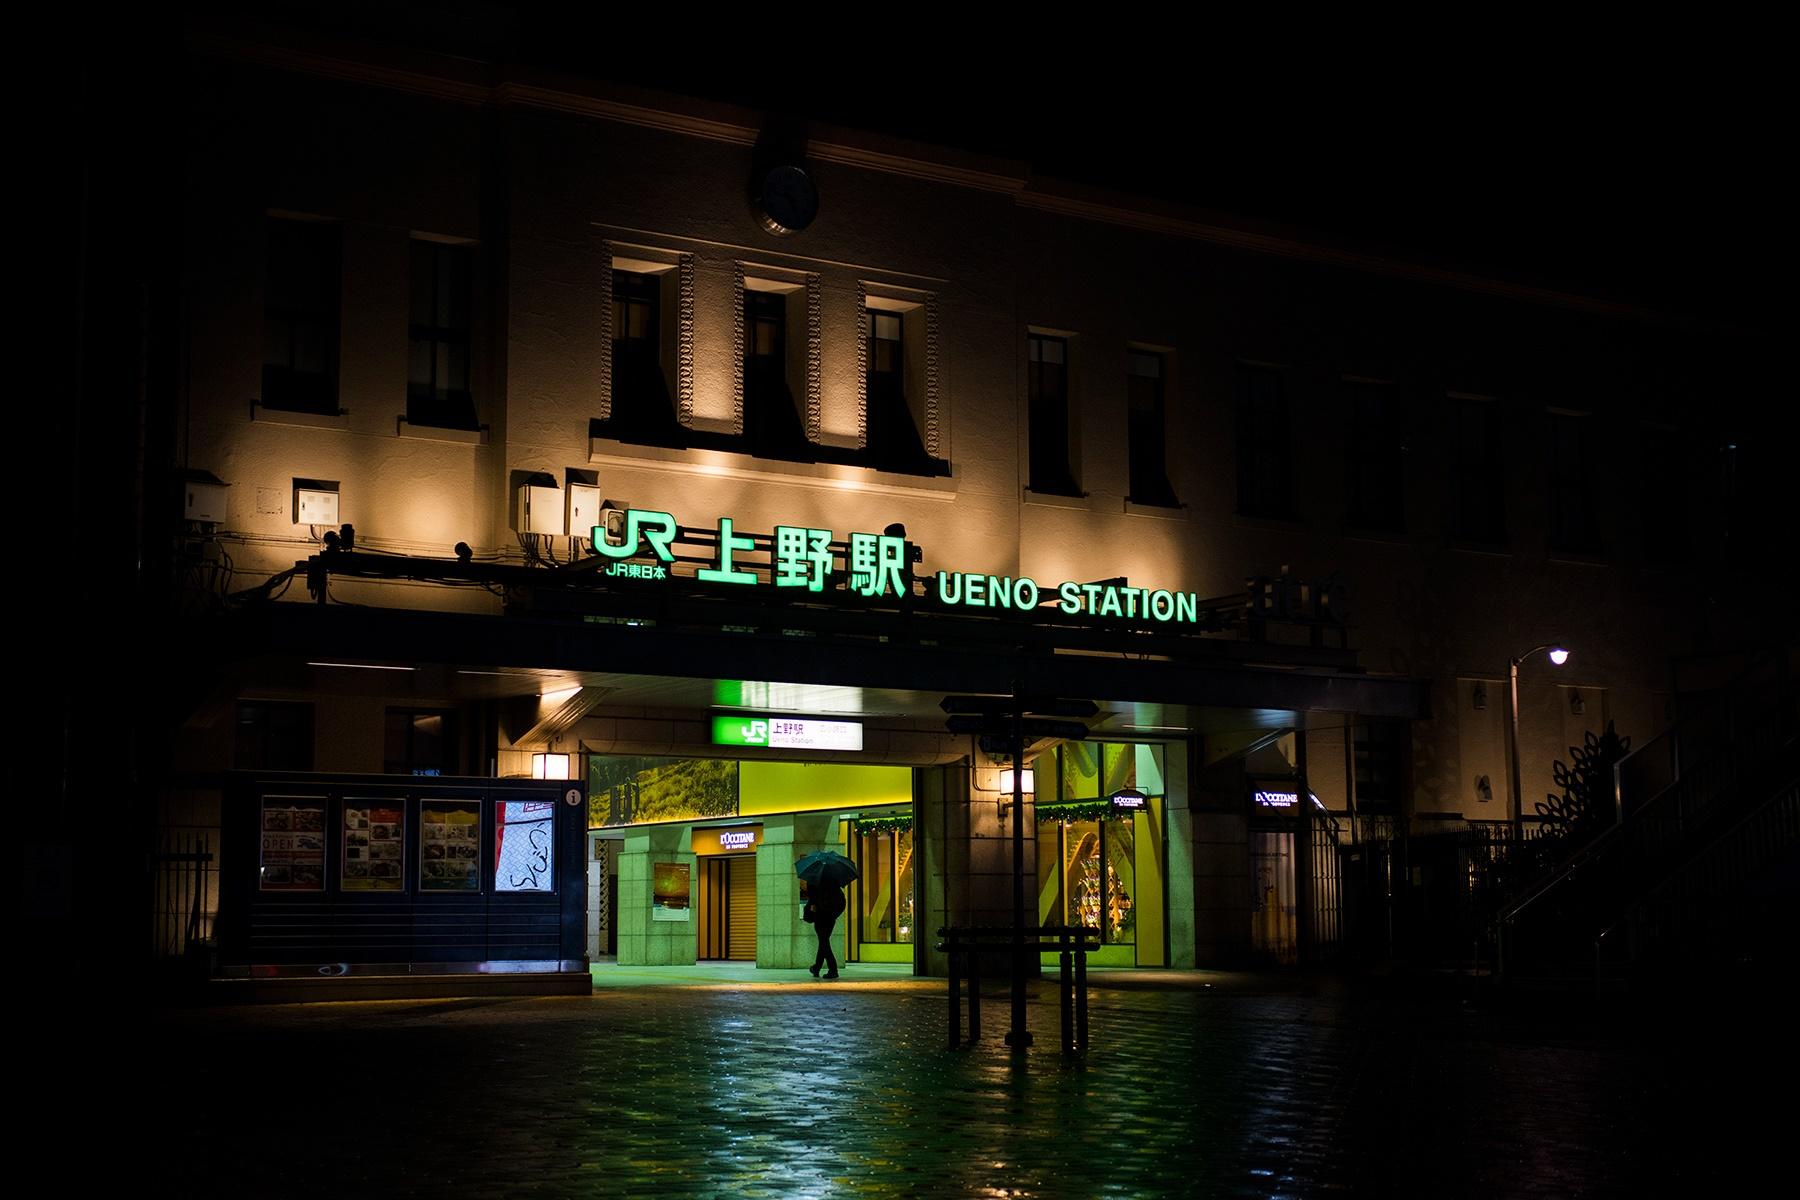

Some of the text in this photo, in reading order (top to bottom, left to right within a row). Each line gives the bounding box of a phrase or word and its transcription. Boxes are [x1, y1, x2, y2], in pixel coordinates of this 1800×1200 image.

[592, 509, 677, 562] JR
[697, 518, 906, 598] 上野駅
[605, 562, 666, 580] JR東日本
[938, 571, 1198, 623] UENO STATION
[742, 720, 767, 738] JR
